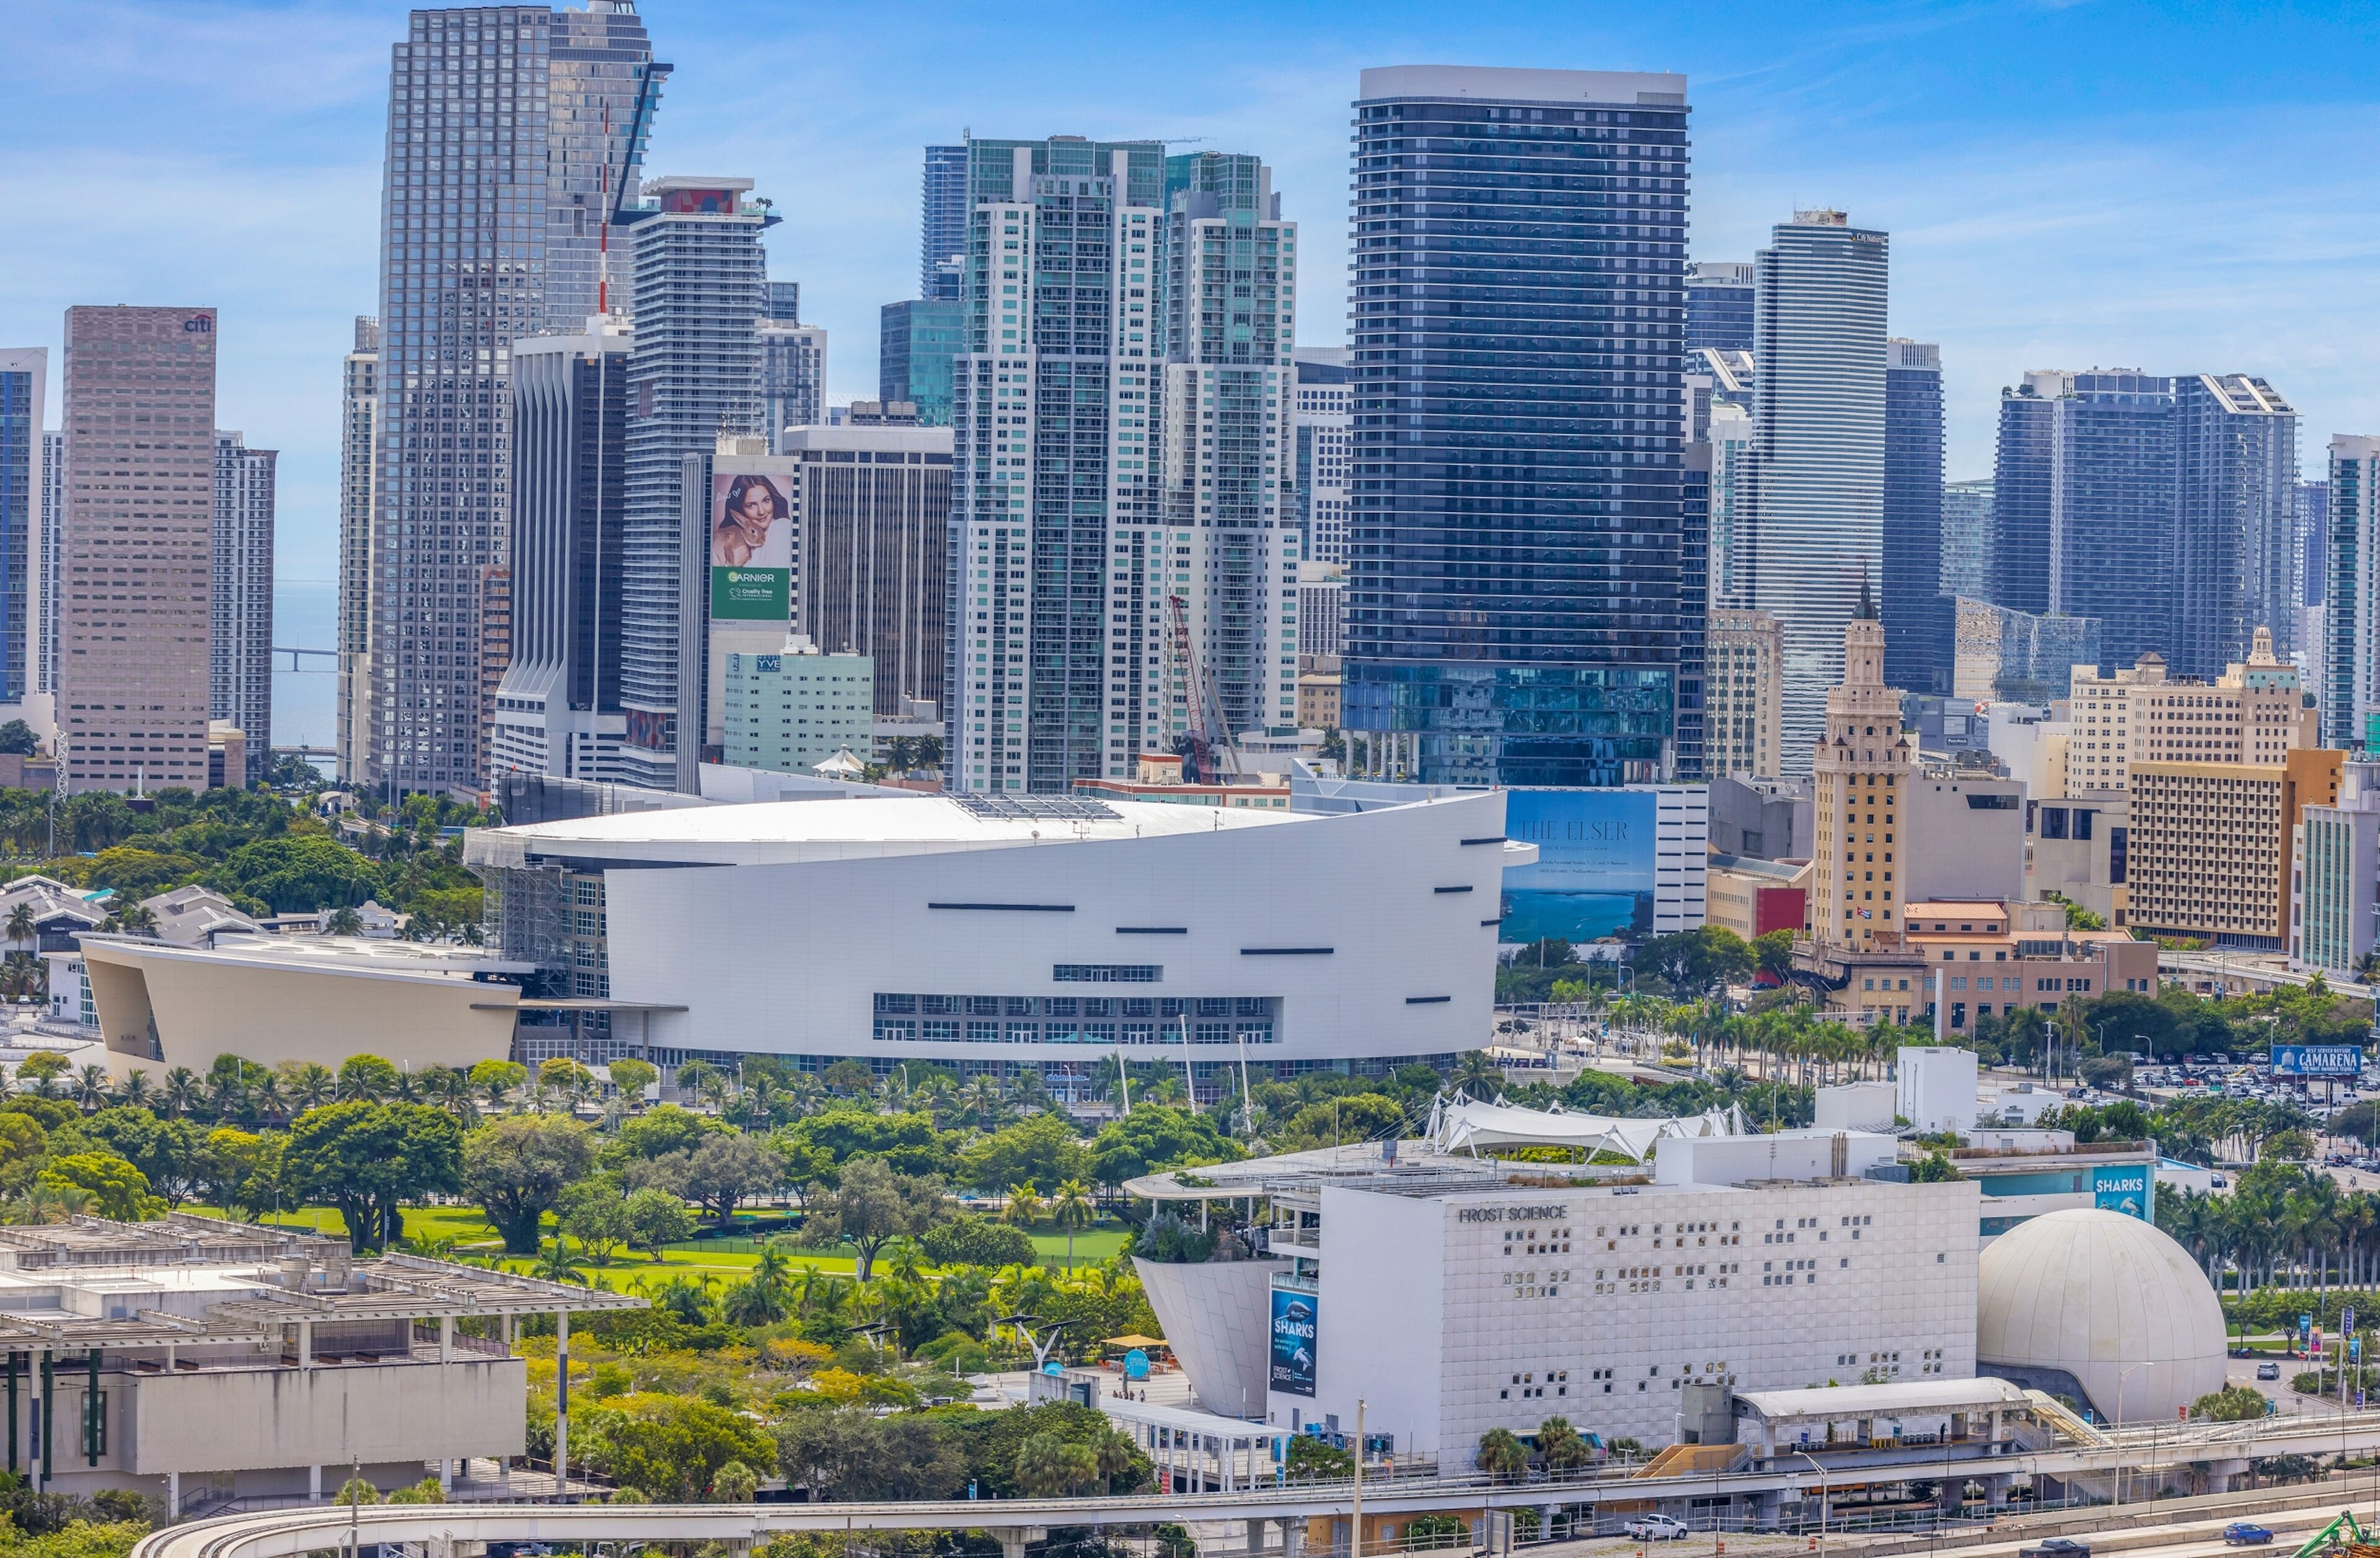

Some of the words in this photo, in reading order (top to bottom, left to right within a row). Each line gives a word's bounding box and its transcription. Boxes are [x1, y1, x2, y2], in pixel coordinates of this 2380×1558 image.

[185, 317, 211, 332] citi
[728, 573, 775, 583] GARNIER
[758, 660, 780, 668] YVE
[1519, 820, 1558, 840] THE
[1567, 821, 1628, 841] ELSER
[2299, 1053, 2357, 1067] CAMARENA
[2096, 1178, 2143, 1193] SHARKS
[1460, 1208, 1505, 1223] FROST
[1509, 1205, 1567, 1221] SCIENCE
[1274, 1320, 1314, 1339] SHARKS
[1273, 1366, 1288, 1374] FROST
[1273, 1372, 1292, 1382] SCIENCE
